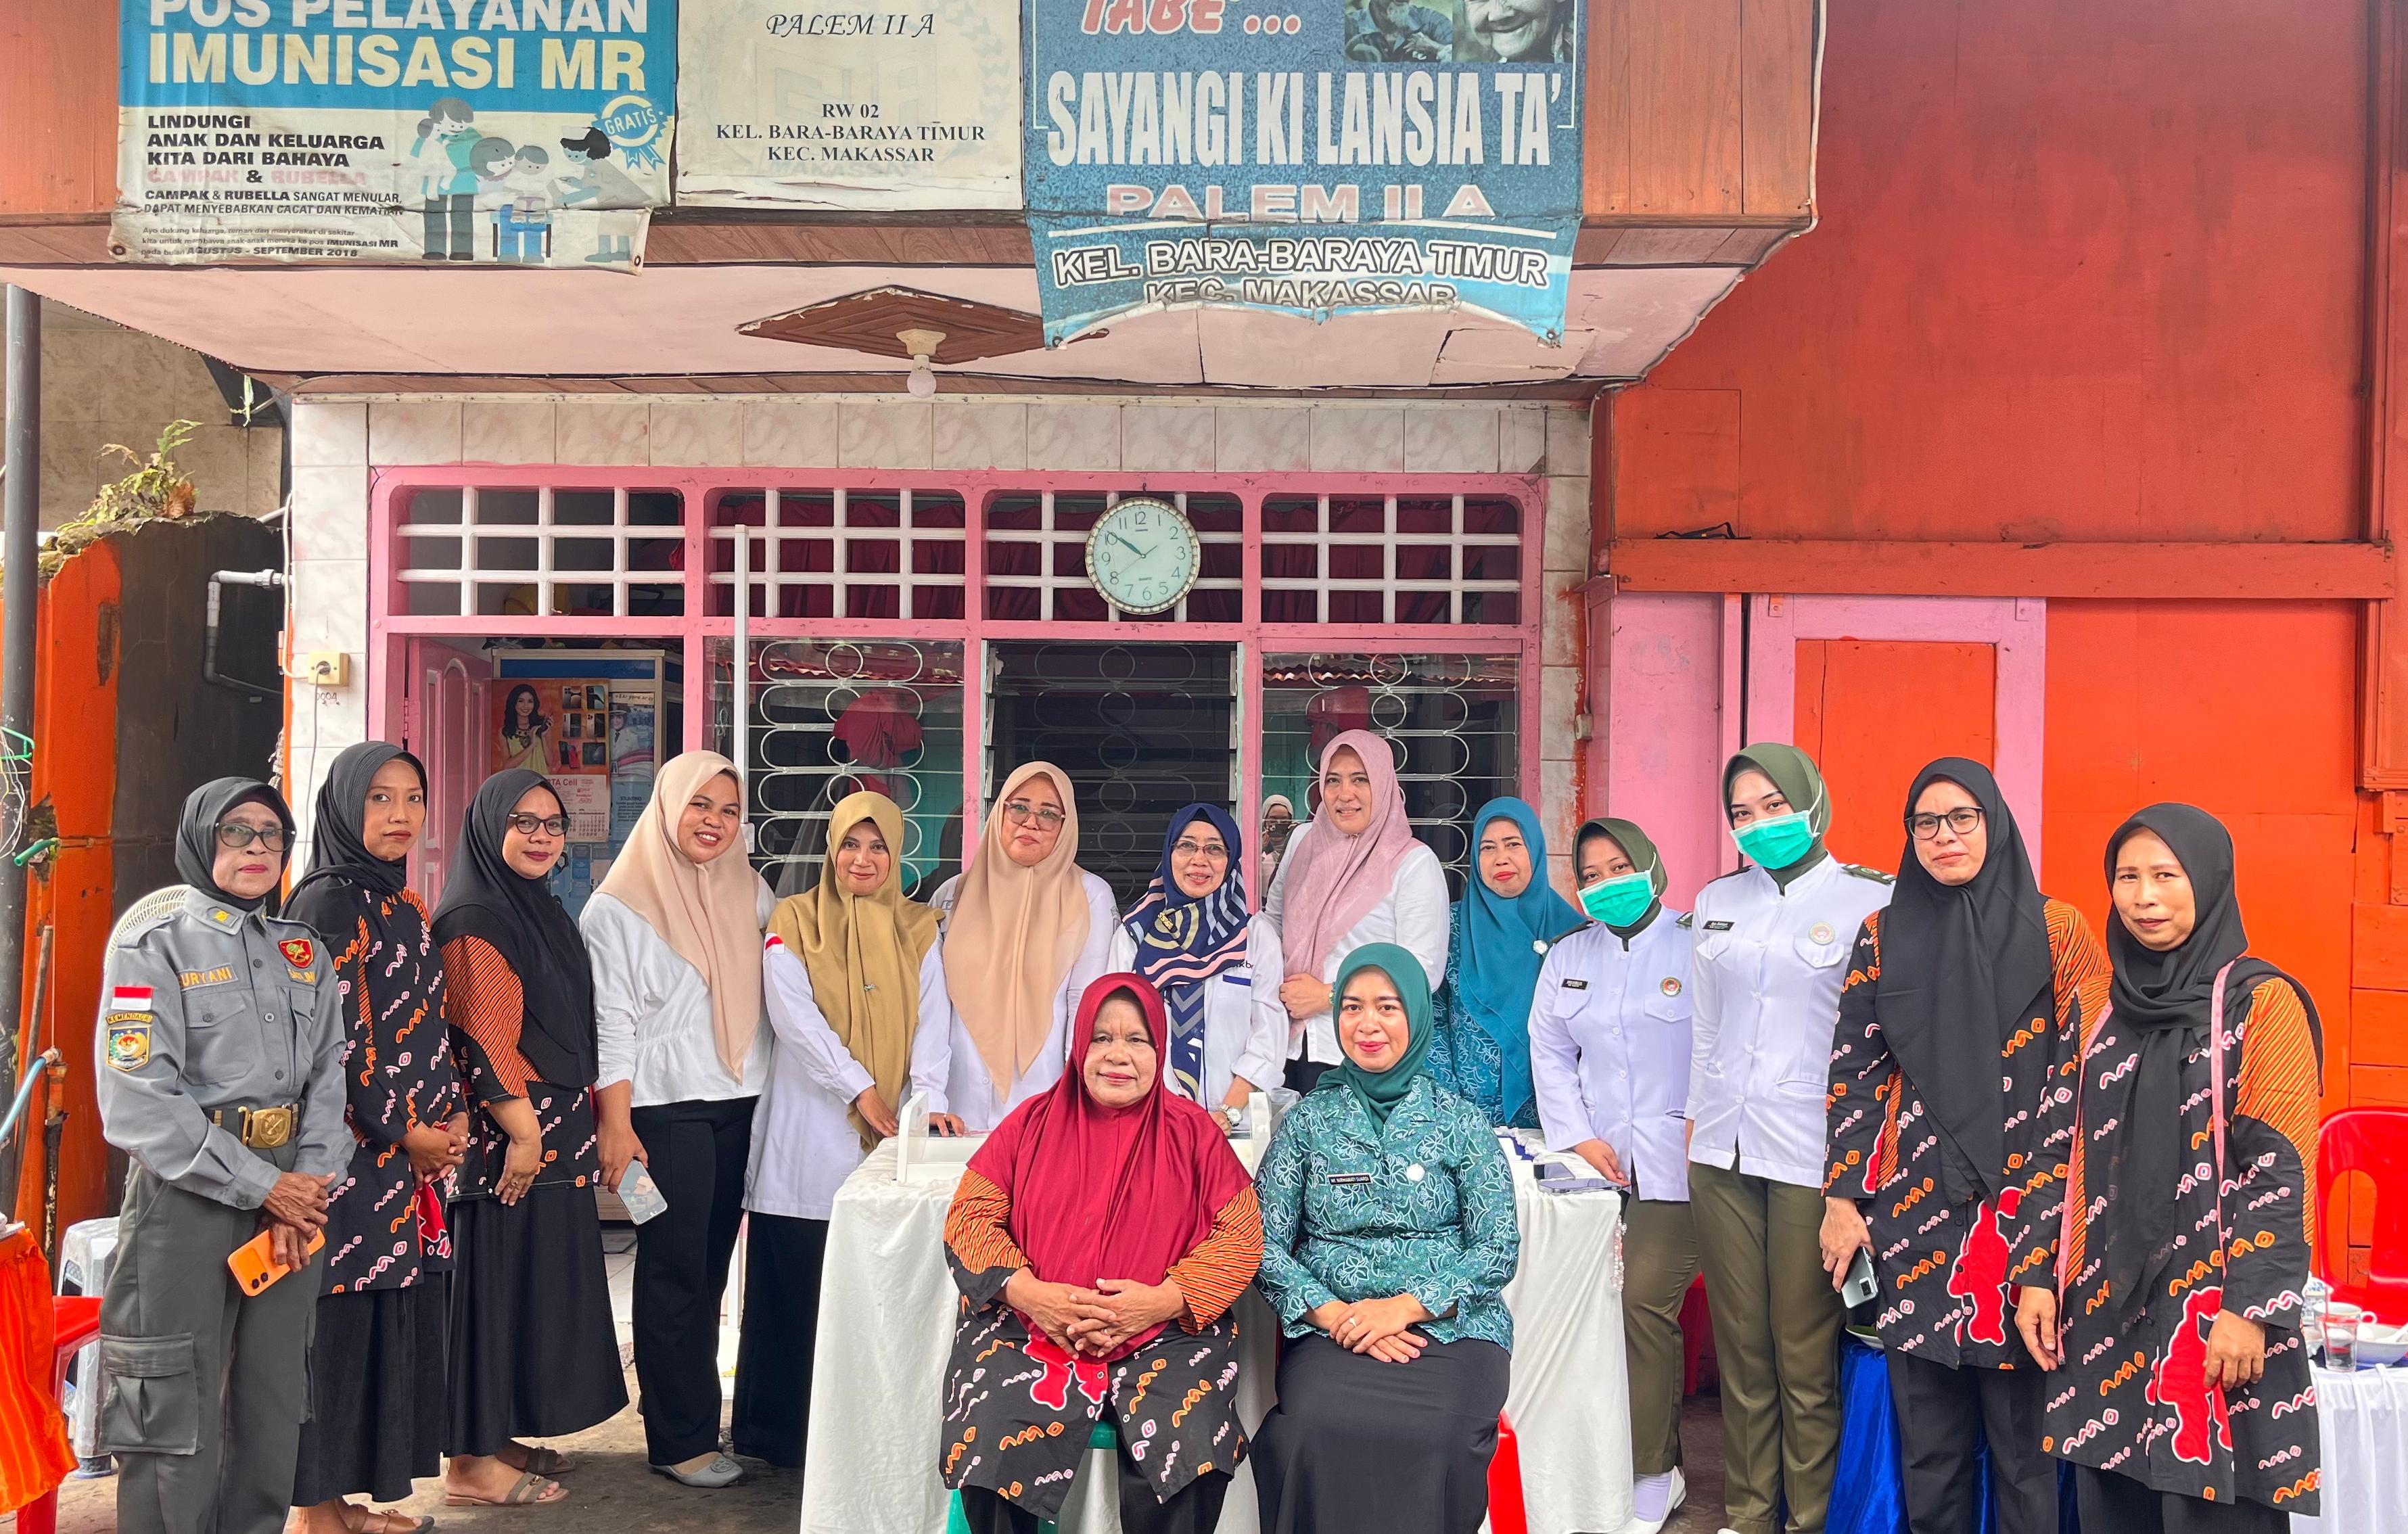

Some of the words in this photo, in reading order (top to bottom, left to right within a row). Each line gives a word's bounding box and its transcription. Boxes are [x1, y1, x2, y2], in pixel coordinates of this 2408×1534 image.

[149, 0, 271, 28] POS
[292, 0, 647, 33] PELAYANAN
[766, 14, 877, 38] PALEM
[882, 14, 909, 35] II
[911, 14, 935, 38] A
[149, 33, 514, 89] IMUNISASI
[541, 38, 646, 91] MR
[822, 103, 855, 118] RW
[860, 103, 879, 118] 02
[147, 115, 251, 129] LINDUNGI
[604, 108, 657, 135] GRATIS
[1047, 70, 1243, 167] SAYANGI
[1256, 72, 1304, 166] KI
[1317, 70, 1484, 167] LANSIA
[716, 124, 762, 139] KEL.
[768, 125, 912, 141] BARA-BARAYA
[917, 125, 986, 141] TIMUR
[147, 133, 208, 147] ANAK
[215, 133, 260, 147] DAN
[269, 135, 386, 149] KELUARGA
[147, 152, 195, 165] KITA
[203, 152, 254, 165] DARI
[262, 152, 350, 167] BAHAYA
[768, 146, 815, 161] KEC.
[821, 147, 934, 162] MAKASSAR
[147, 170, 239, 184] CAMPAK
[246, 170, 263, 183] &
[270, 171, 367, 185] RUBELLA
[145, 190, 209, 200] CAMPAK
[212, 191, 221, 200] &
[224, 191, 290, 201] RUBELLA
[293, 191, 340, 202] SANGAT
[343, 193, 402, 204] MENULAR,
[1107, 185, 1358, 223] PALEM
[1383, 185, 1422, 221] II
[1441, 185, 1496, 217] A
[144, 204, 181, 213] DAPAT
[184, 204, 273, 214] MENYEBABKAN
[277, 205, 314, 214] CACAT
[317, 205, 342, 214] DAN
[327, 239, 377, 248] IMUNISASI
[379, 239, 398, 248] MR
[187, 246, 242, 255] AGUSTUS
[253, 247, 323, 256] SEPTEMBER
[327, 248, 358, 257] 2018
[1054, 246, 1142, 287] KEL.
[1147, 239, 1423, 274] BARA-BARAYA
[1429, 243, 1548, 286] TIMUR
[1146, 279, 1235, 304] KEC.
[1243, 279, 1458, 308] MAKASSAR
[1119, 517, 1128, 530] 11
[1134, 511, 1146, 525] 12
[1105, 532, 1117, 545] 10
[1169, 526, 1178, 539] 2
[1101, 552, 1111, 566] 9
[1175, 546, 1186, 560] 3
[1110, 571, 1119, 584] 8
[1172, 566, 1180, 579] 4
[1125, 584, 1134, 597] 7
[1142, 586, 1151, 601] 6
[1159, 582, 1168, 595] 5
